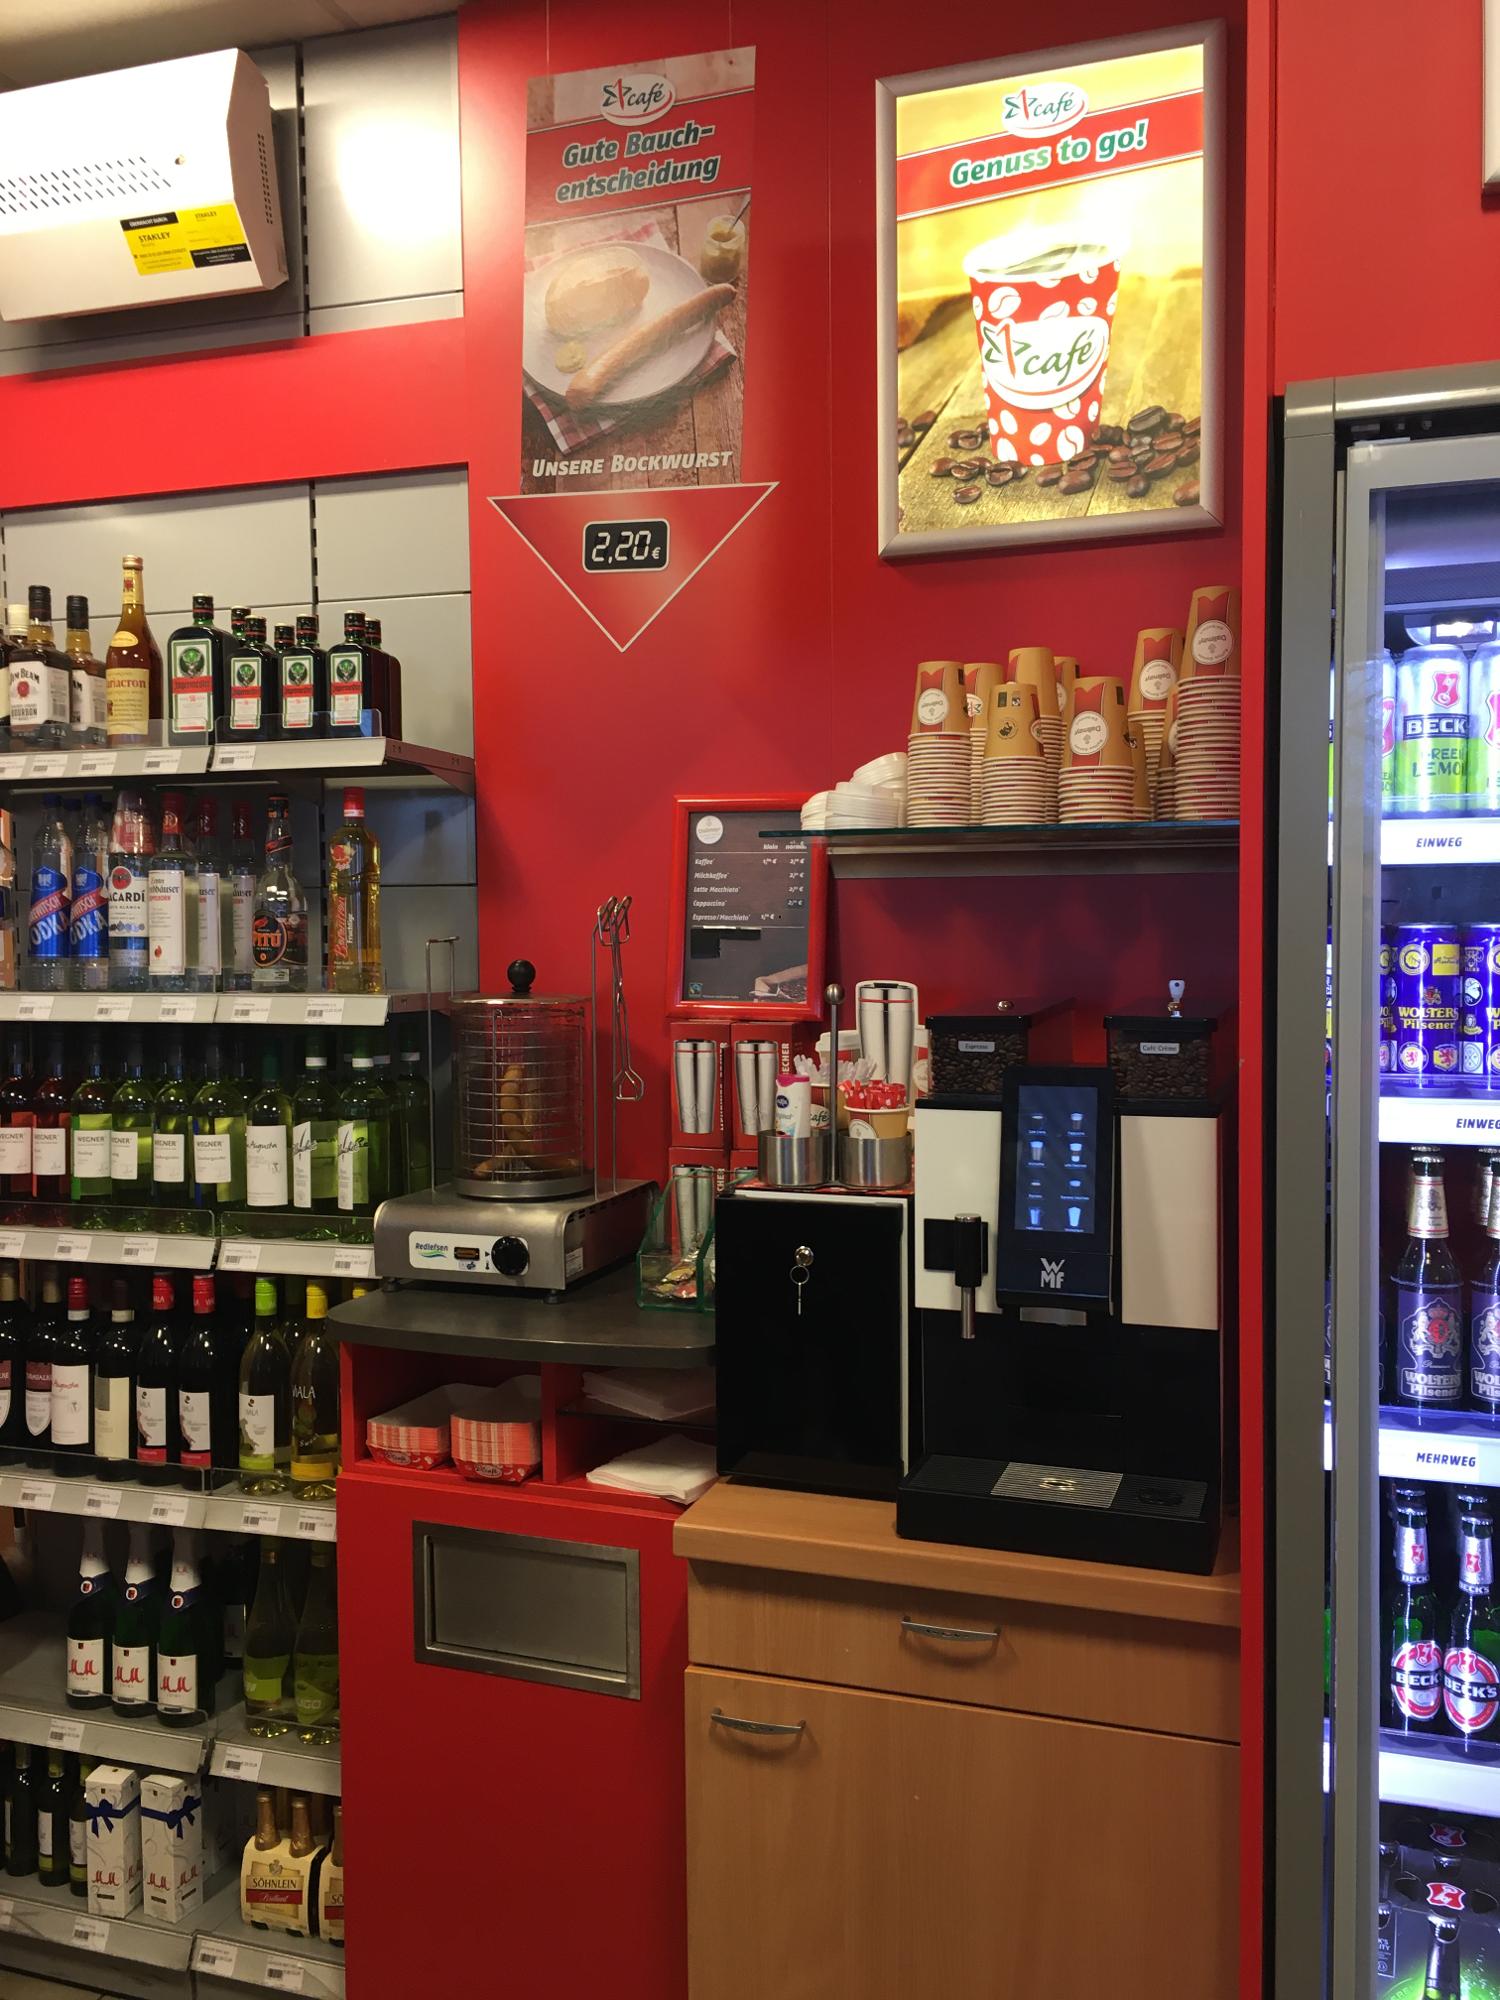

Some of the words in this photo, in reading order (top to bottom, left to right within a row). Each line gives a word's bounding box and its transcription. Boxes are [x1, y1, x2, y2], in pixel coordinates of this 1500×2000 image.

[627, 83, 666, 112] café
[1033, 92, 1075, 122] café
[562, 139, 619, 168] Gute
[624, 120, 715, 158] Bauch-
[951, 146, 1052, 188] Genuss
[1058, 135, 1090, 163] to
[1095, 118, 1149, 162] go!
[555, 155, 721, 203] entscheidung
[1023, 328, 1095, 386] café
[20, 667, 40, 684] BEAM
[1407, 718, 1467, 734] BECK
[1416, 837, 1463, 848] EINWEG
[109, 890, 145, 902] ACARDÍ
[31, 911, 67, 945] ODKA
[70, 910, 108, 945] ODKA
[1398, 1007, 1459, 1020] WOLTERS
[1403, 1019, 1456, 1030] Pilsener
[781, 1042, 790, 1075] ECHER
[1416, 1452, 1477, 1468] MEHRWEG
[1396, 1672, 1440, 1686] BECK
[1444, 1677, 1498, 1699] BECK'S
[252, 1877, 297, 1889] SÖHNLEIN
